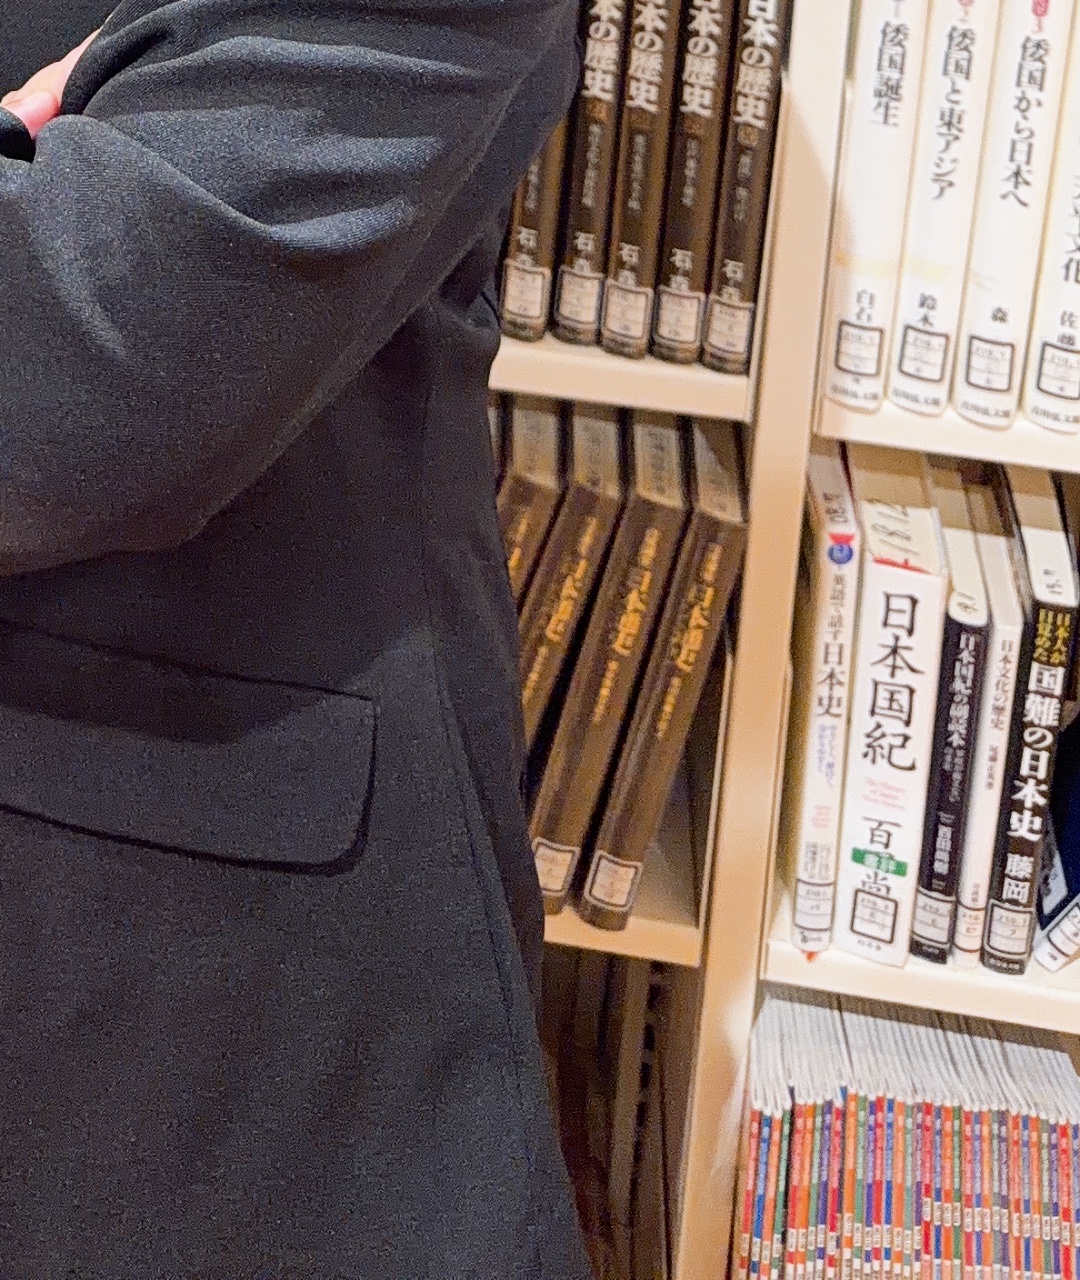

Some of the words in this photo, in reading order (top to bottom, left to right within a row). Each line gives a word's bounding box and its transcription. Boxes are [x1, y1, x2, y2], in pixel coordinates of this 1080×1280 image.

[872, 20, 909, 128] 倭国誕生
[929, 25, 974, 200] 倭国と東アジア
[998, 35, 1050, 208] 倭国から日本へ
[863, 590, 924, 772] 日本国紀
[1006, 664, 1066, 840] 国難の日本史
